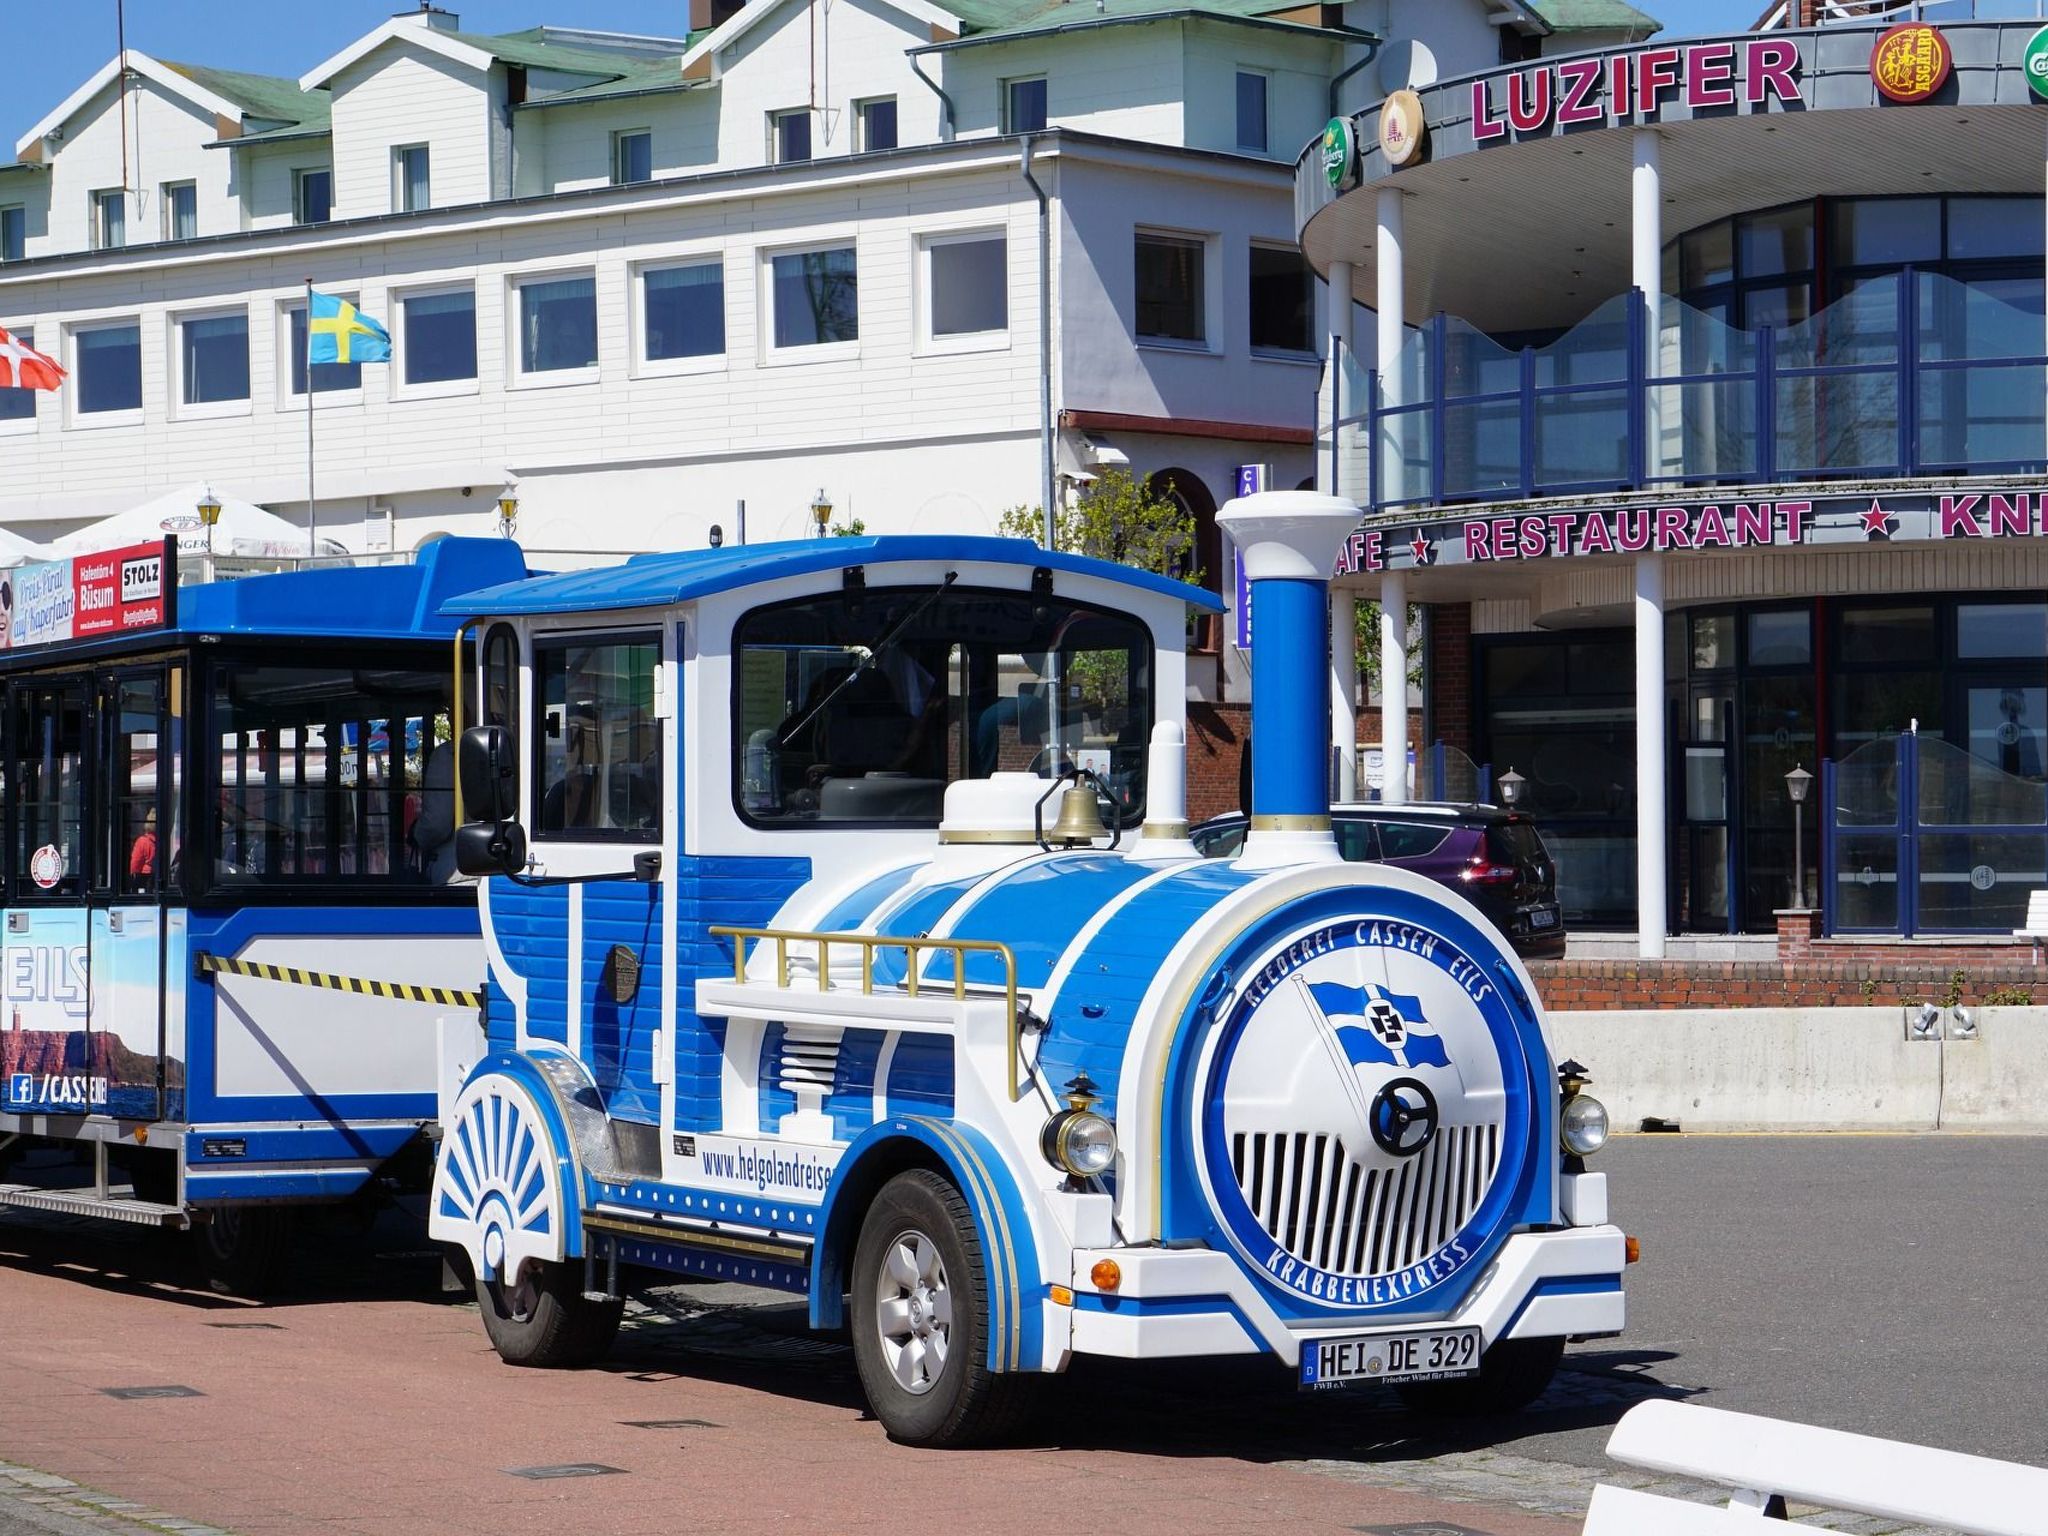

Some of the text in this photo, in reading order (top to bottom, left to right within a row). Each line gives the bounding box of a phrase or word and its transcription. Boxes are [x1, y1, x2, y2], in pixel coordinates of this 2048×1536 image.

[1471, 38, 1802, 141] LUZIFER
[1915, 28, 1933, 92] ASGAARD
[1335, 493, 2048, 577] AFE RESTAURANT KN
[80, 584, 114, 611] Büsum
[124, 563, 159, 586] STOLZ
[7, 946, 95, 1017] EILS
[1244, 921, 1493, 1008] REEDEREI CASSEN EILS
[702, 1144, 834, 1192] www.helgolandreise
[1265, 1237, 1469, 1303] KRABBENEXPRESS
[1306, 1334, 1475, 1377] D HEI DE 329
[1411, 1373, 1431, 1382] Wind
